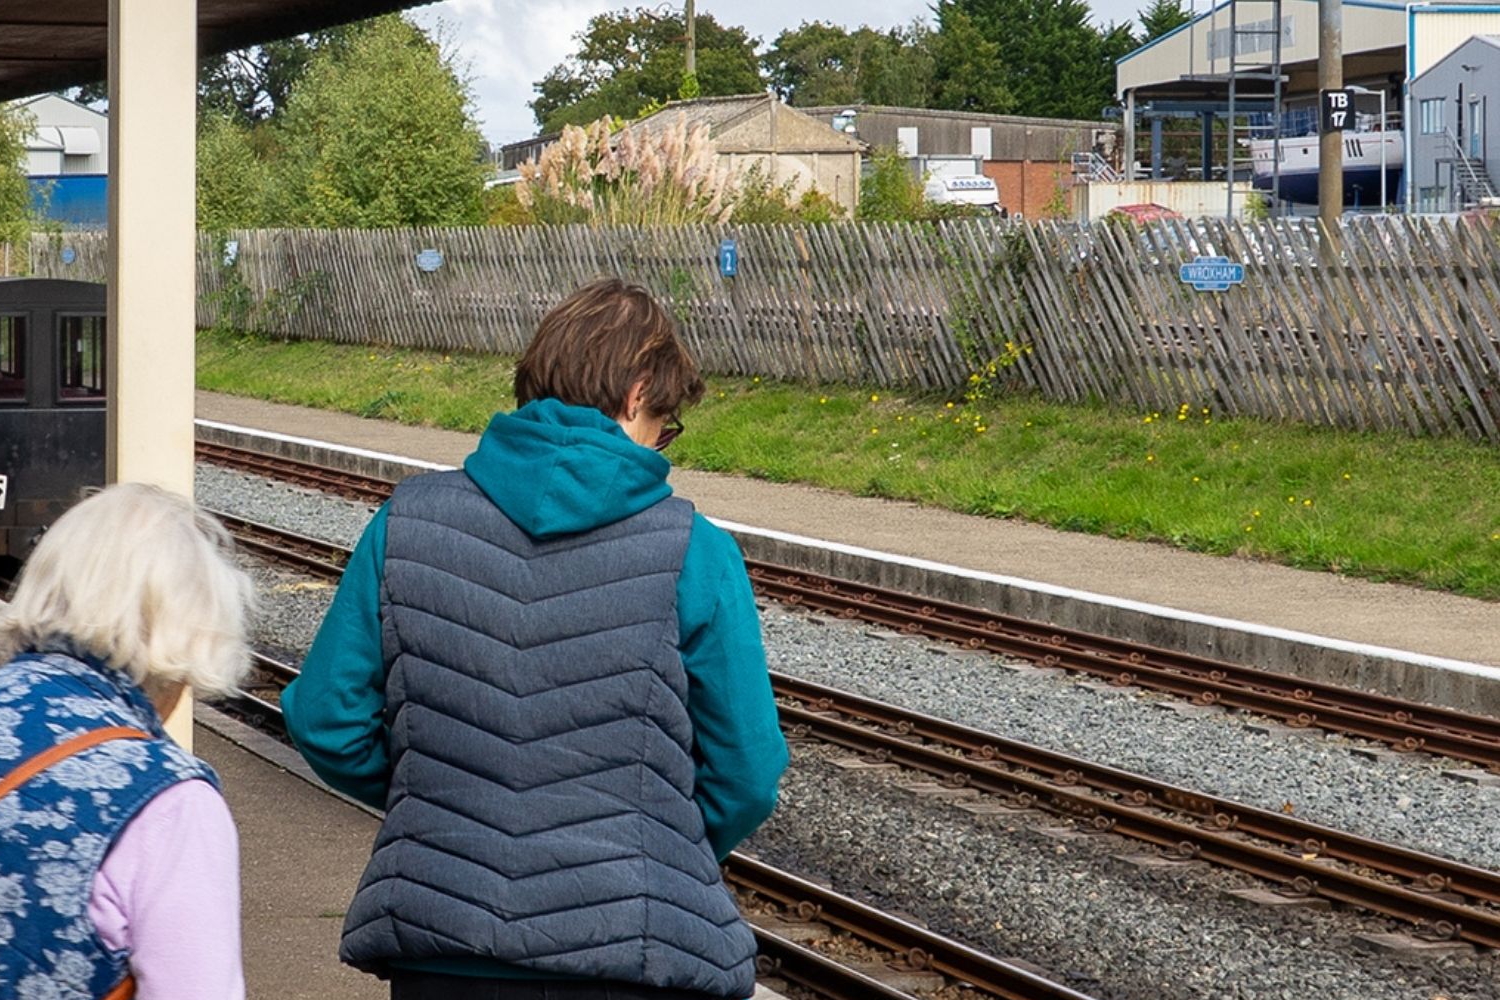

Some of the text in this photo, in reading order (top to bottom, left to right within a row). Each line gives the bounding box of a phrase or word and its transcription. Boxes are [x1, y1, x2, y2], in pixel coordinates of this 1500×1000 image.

[1328, 93, 1348, 108] TB
[1331, 111, 1347, 127] 17
[1188, 266, 1236, 280] WROXHAM
